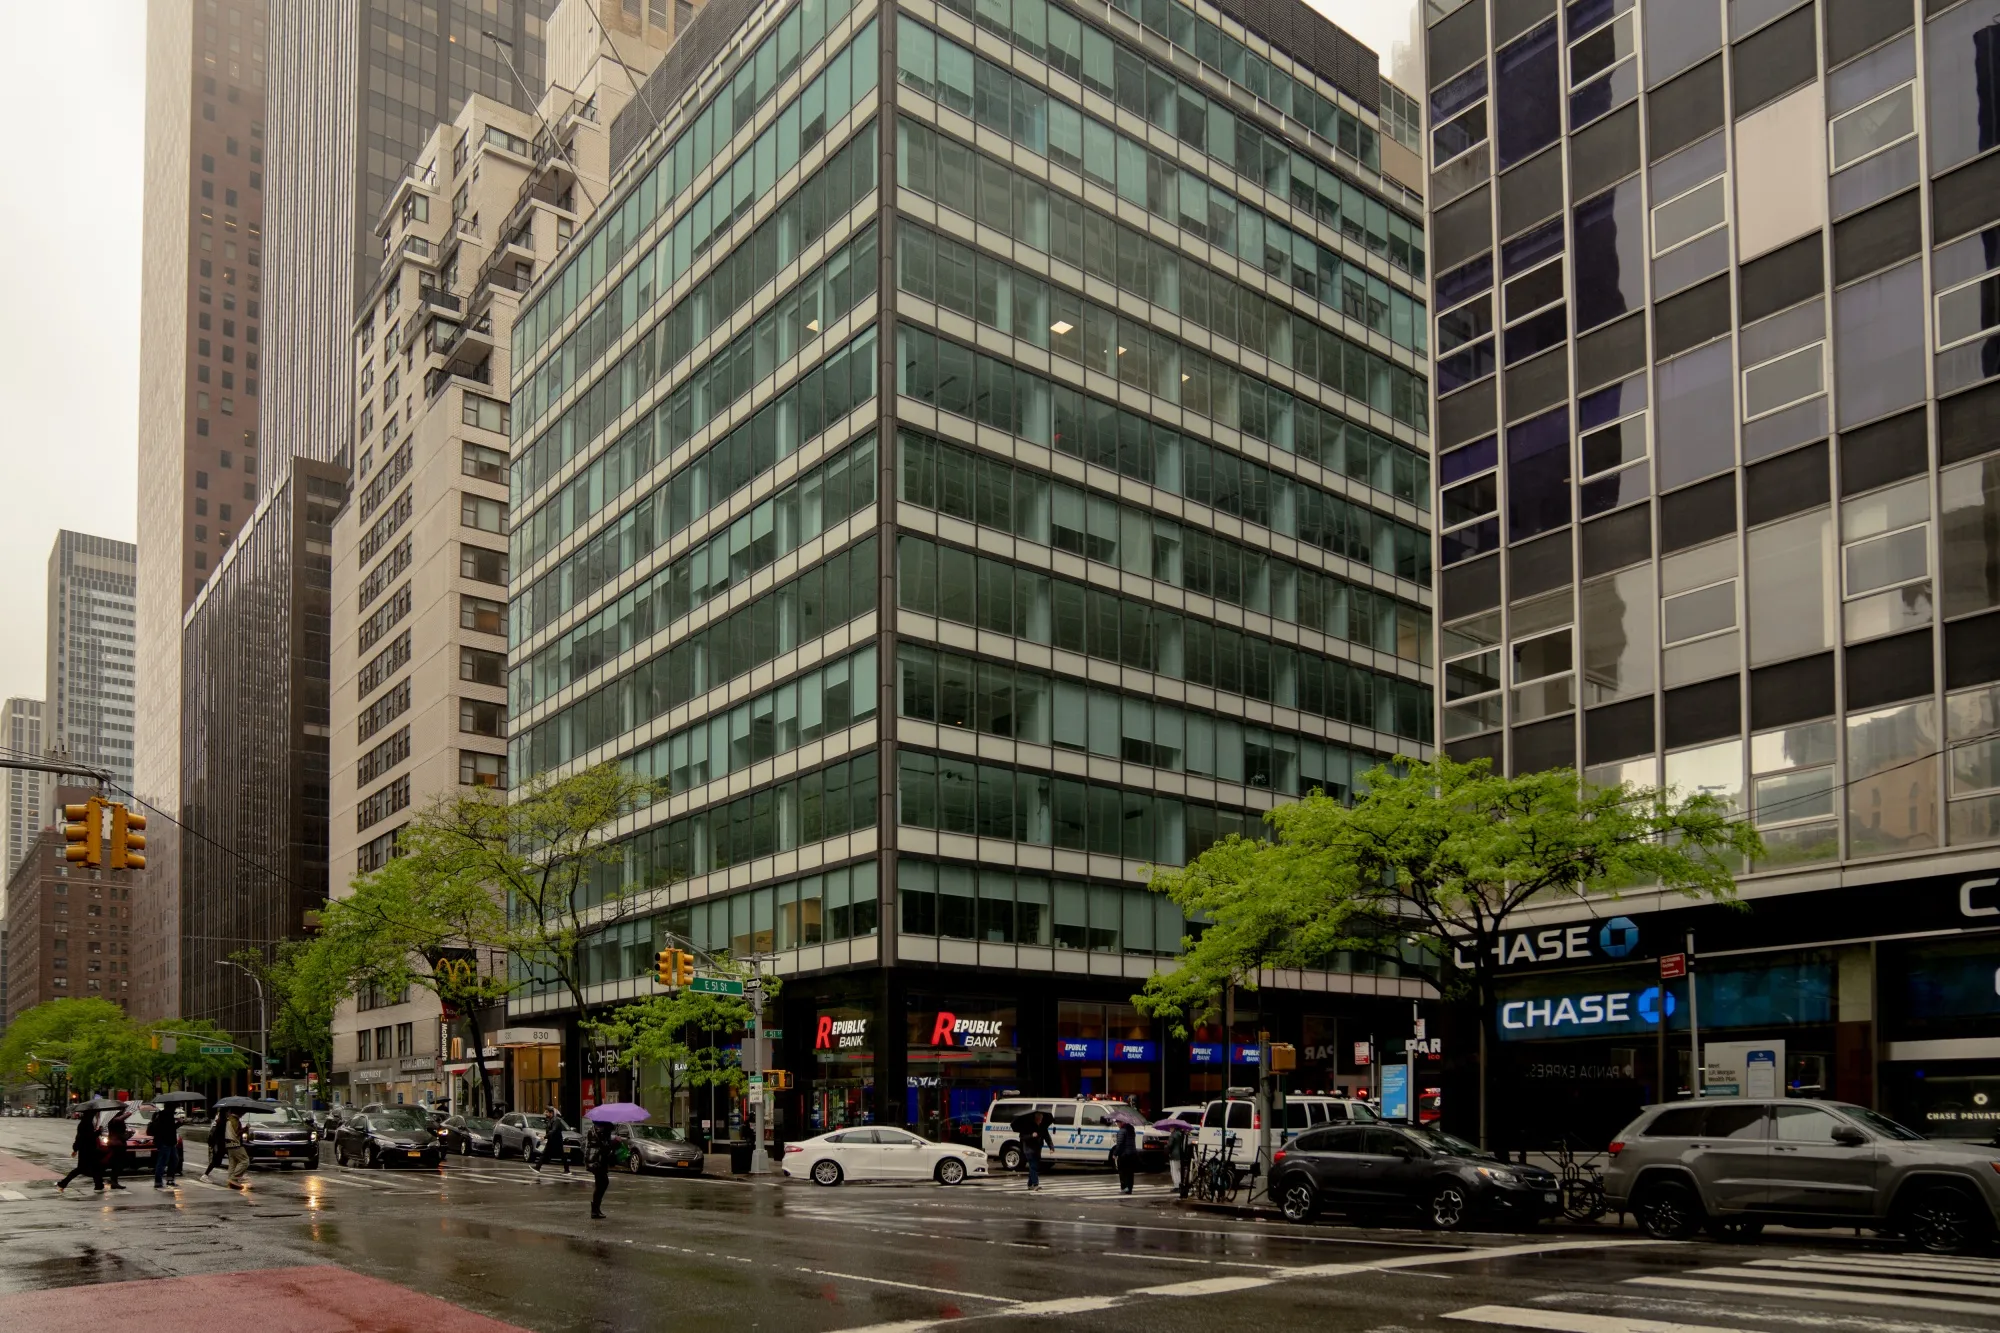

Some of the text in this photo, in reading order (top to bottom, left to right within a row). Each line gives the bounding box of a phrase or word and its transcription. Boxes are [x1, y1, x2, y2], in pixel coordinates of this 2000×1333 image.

[1454, 926, 1593, 969] CHASE
[704, 980, 728, 992] E 51 St
[1502, 992, 1632, 1029] CHASE
[533, 1031, 549, 1040] 830
[816, 1015, 868, 1049] REPUBLIC
[930, 1011, 1003, 1047] REPUBLIC
[839, 1035, 864, 1048] BANK
[964, 1035, 998, 1048] BANK
[1926, 1112, 1957, 1120] CHASE
[1068, 1133, 1105, 1145] NYPD
